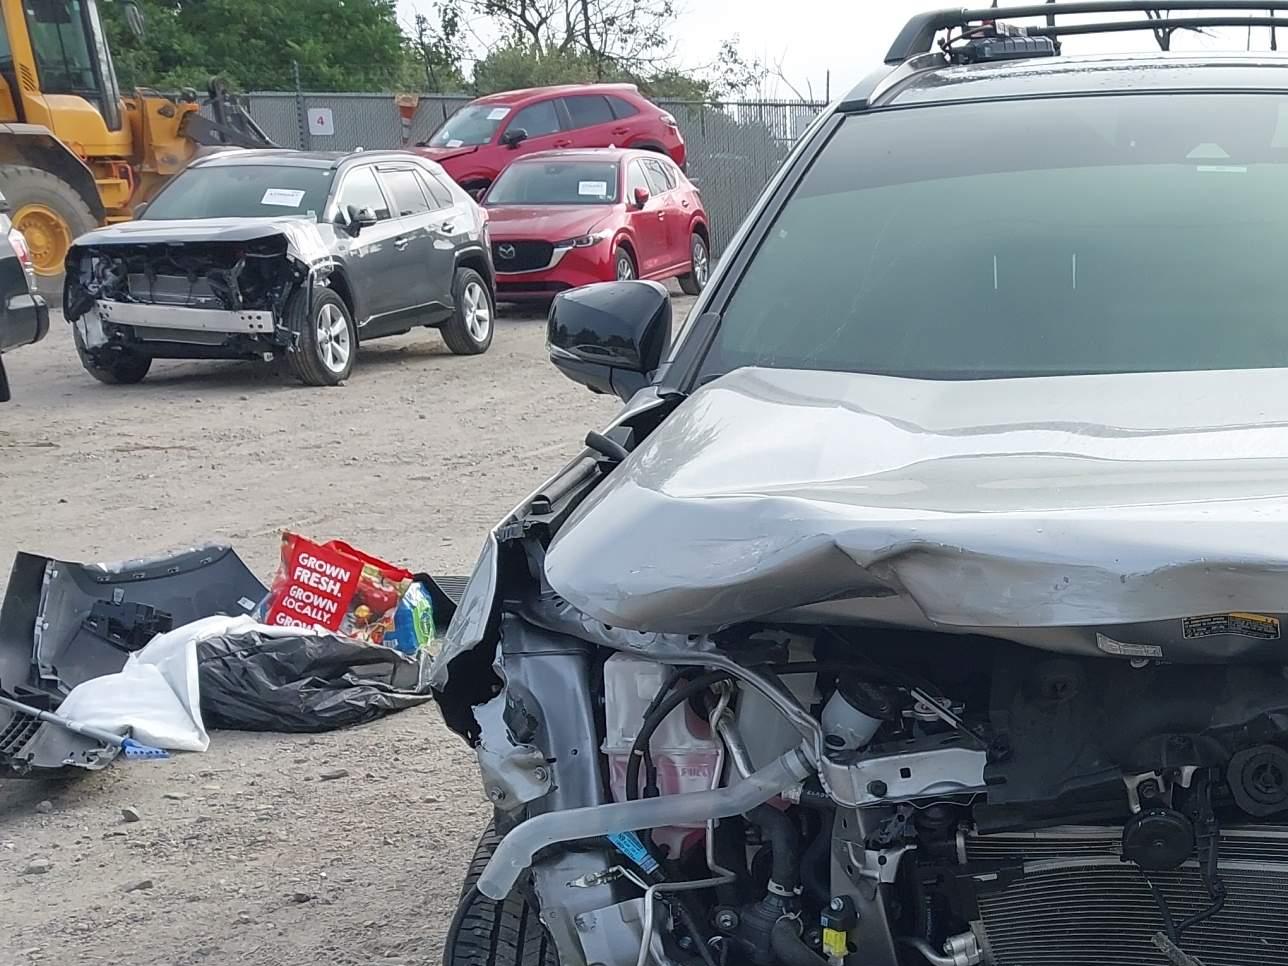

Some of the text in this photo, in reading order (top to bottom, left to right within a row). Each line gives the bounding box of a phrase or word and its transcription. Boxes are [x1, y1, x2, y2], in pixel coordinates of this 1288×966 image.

[316, 115, 324, 126] 4
[293, 566, 342, 598] FRESH.
[298, 552, 351, 582] GROWN
[281, 596, 332, 625] LOCALLY.
[288, 584, 338, 614] GROWN
